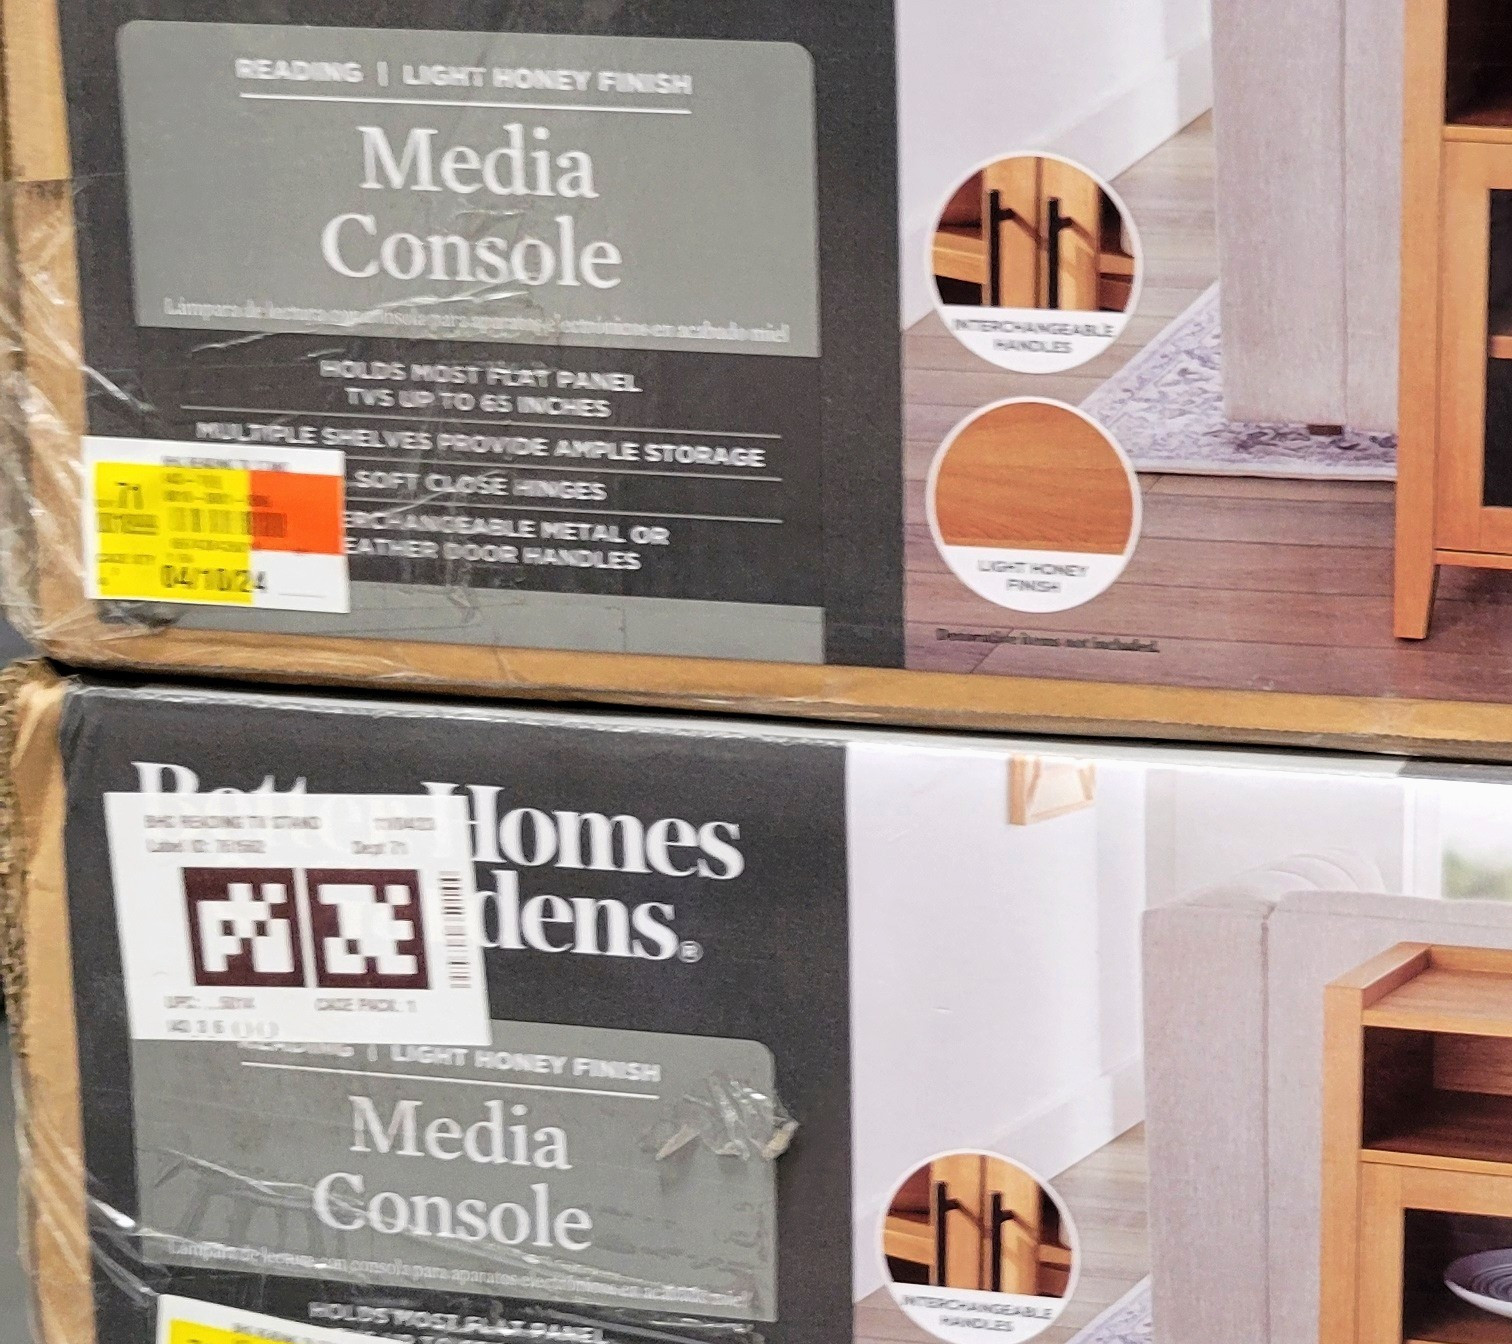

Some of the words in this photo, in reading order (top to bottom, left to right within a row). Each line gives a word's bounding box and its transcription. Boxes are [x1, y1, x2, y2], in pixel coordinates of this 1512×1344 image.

[235, 58, 362, 83] READING
[402, 65, 486, 87] LIGHT
[492, 68, 588, 93] HONEY
[598, 71, 692, 96] FINISH
[356, 123, 599, 199] Media
[321, 213, 622, 290] Console
[954, 316, 1114, 339] INTERCHANGEABLE
[992, 336, 1074, 355] HANDLES
[320, 360, 406, 384] HOLDS
[411, 363, 481, 387] MOST
[487, 367, 553, 389] FLAT
[557, 370, 643, 393] PANEL
[346, 387, 394, 408] TVS
[398, 389, 434, 409] UP
[440, 391, 475, 411] TO
[517, 394, 612, 418] INCHES
[196, 421, 318, 445] MULTIPLE
[321, 426, 433, 450] SHELVES
[437, 431, 551, 457] PROVIDE
[555, 438, 640, 462] AMPLE
[644, 443, 767, 468] STORAGE
[355, 469, 419, 493] SOFT
[426, 473, 507, 497] CLOSE
[512, 478, 607, 502] HINGES
[540, 521, 626, 544] METAL
[631, 525, 670, 546] OR
[343, 535, 439, 559] EATHER
[446, 540, 518, 564] DOOR
[523, 546, 642, 571] HANDLES
[978, 558, 1026, 577] LIGHT
[1031, 562, 1088, 580] HONEY
[1005, 577, 1060, 595] FINISH
[390, 1044, 468, 1066] LIGHT
[474, 1050, 567, 1075] HONEY
[572, 1057, 662, 1082] FINISH
[348, 1095, 572, 1170] Media
[312, 1171, 594, 1251] Console
[308, 1301, 390, 1324] HOLDS
[392, 1308, 459, 1329] MOST
[903, 1293, 1052, 1320] INTERCHANGEABLE
[938, 1314, 1014, 1333] HANDLES
